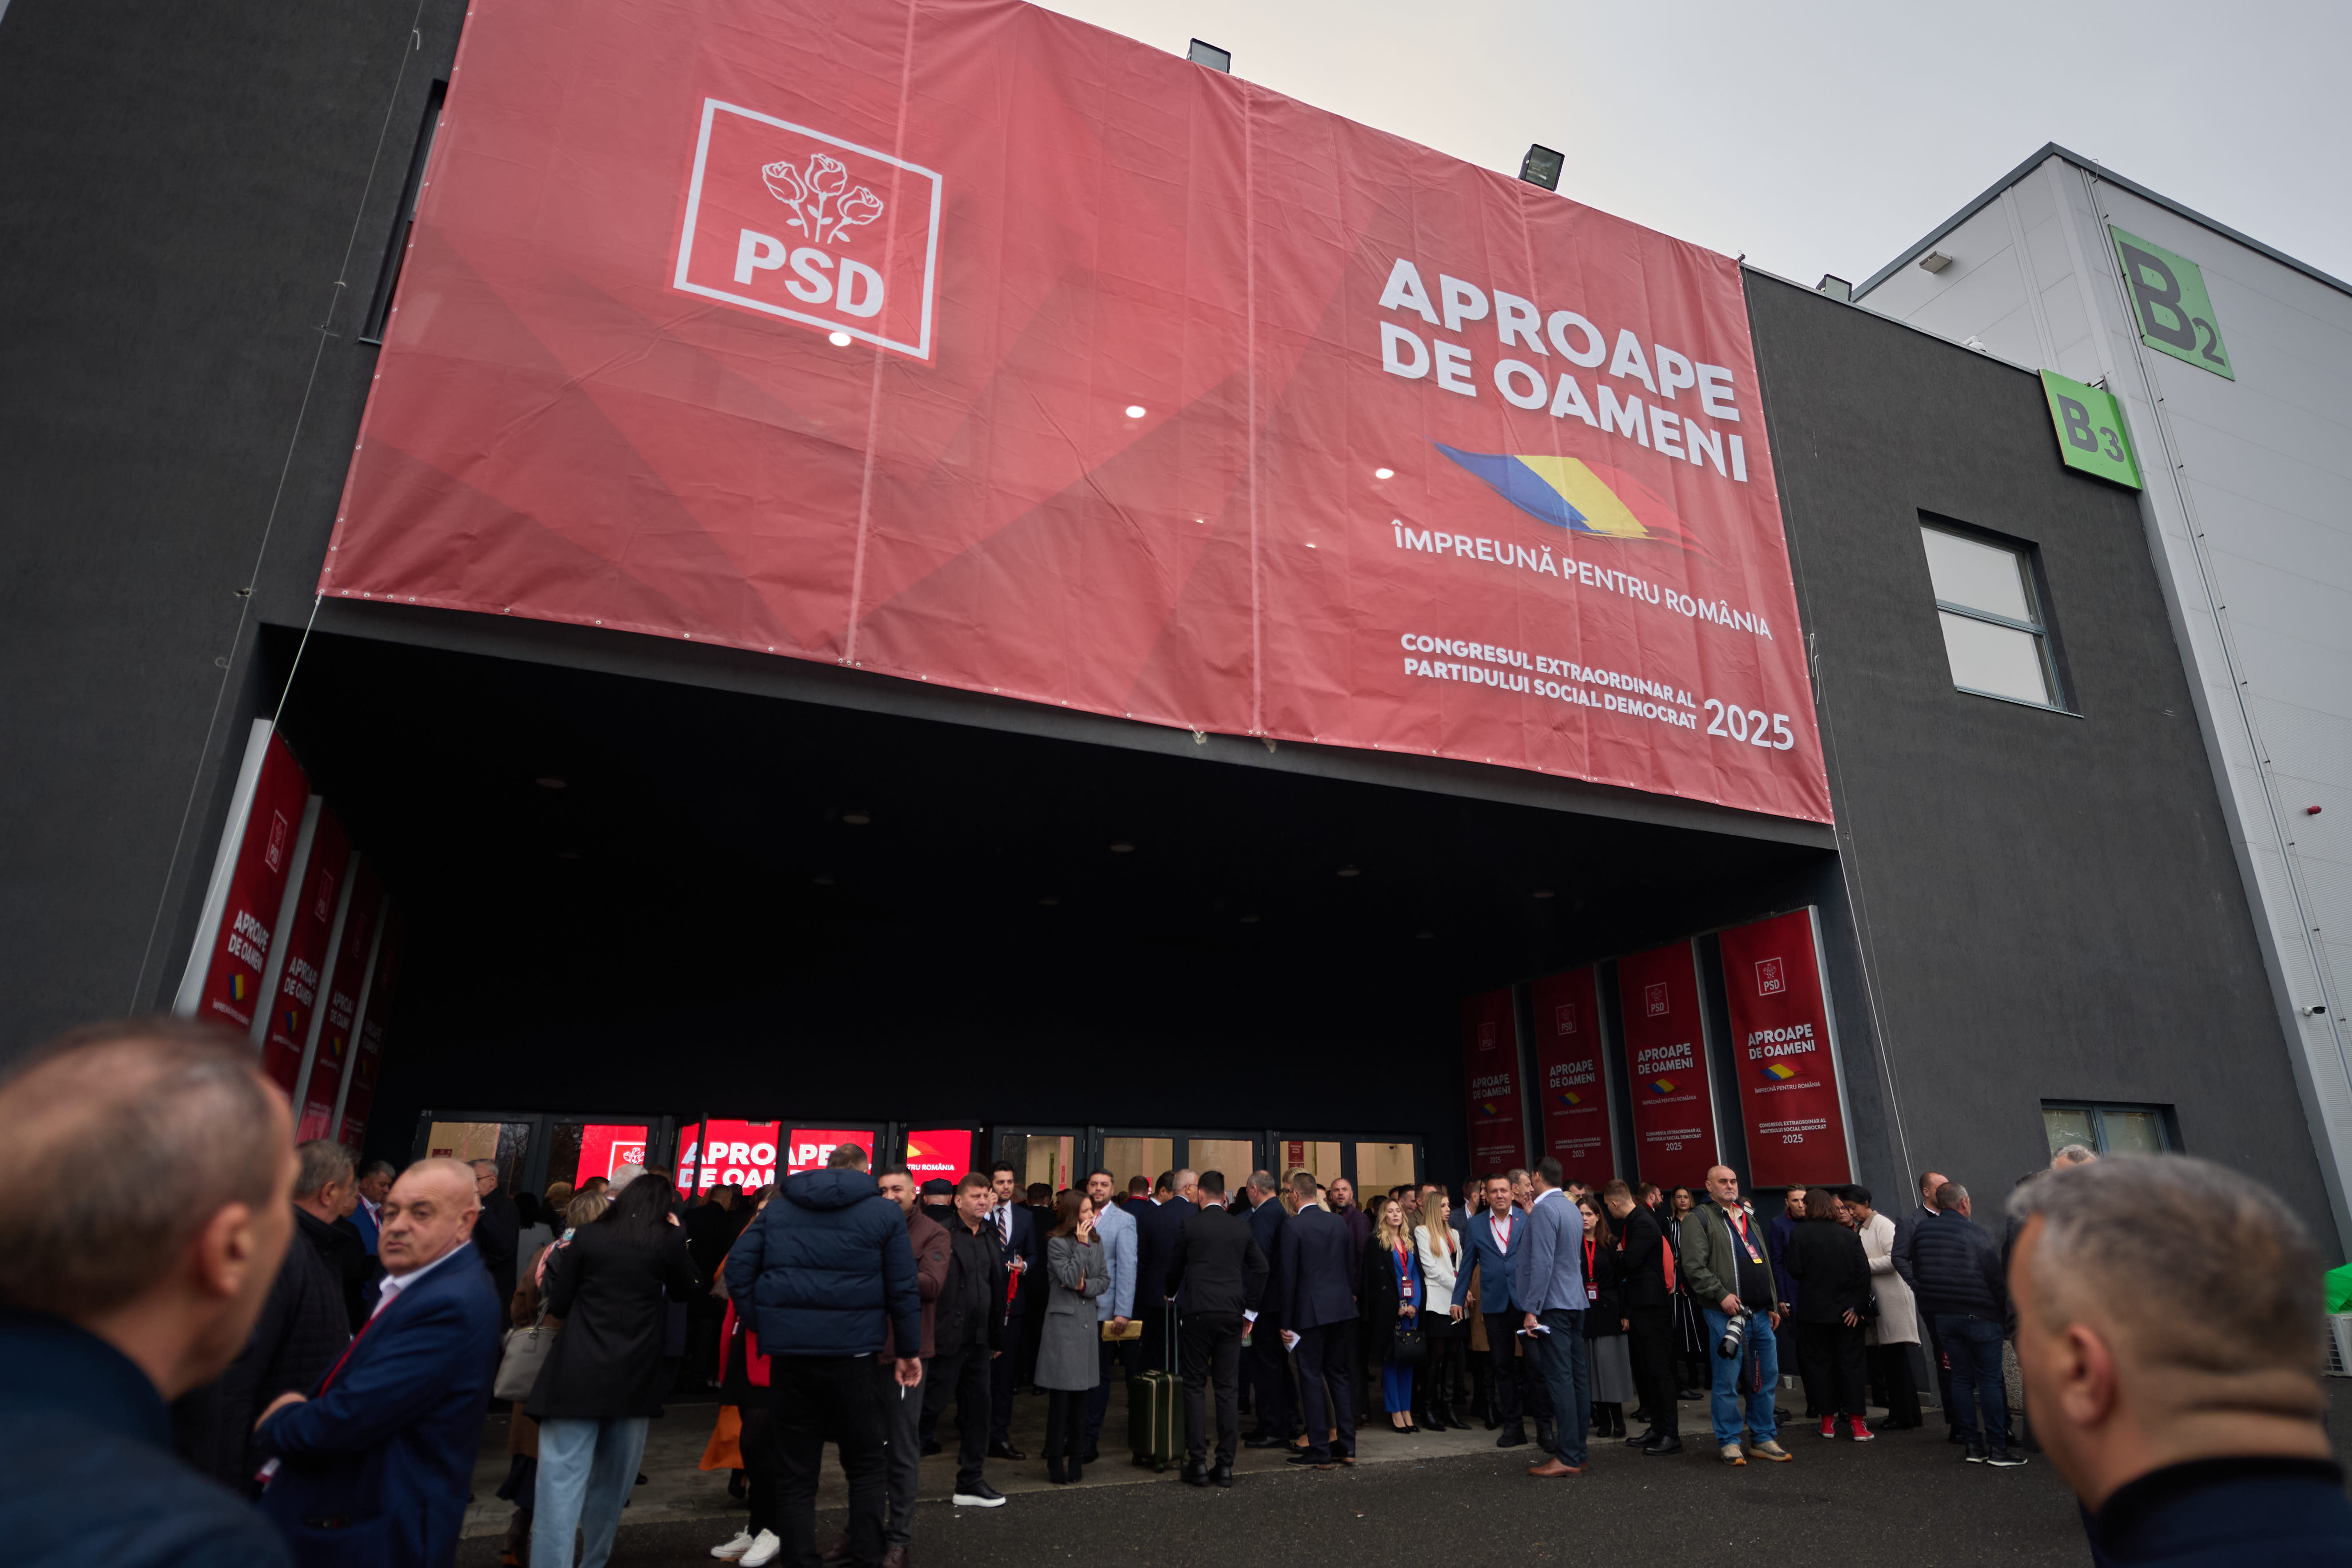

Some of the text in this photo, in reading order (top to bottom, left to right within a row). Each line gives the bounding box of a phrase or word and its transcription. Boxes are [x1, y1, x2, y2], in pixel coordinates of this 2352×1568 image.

[734, 228, 884, 318] PSD
[2119, 241, 2225, 366] B2
[1379, 258, 1740, 421] APROAPE
[1380, 321, 1747, 482] DE OAMENI
[2056, 393, 2125, 463] B3
[1391, 520, 1772, 640] ÎMPREUNĂ PENTRU ROMÂNIA
[1400, 634, 1696, 709] CONGRESUL EXTRAORDINAR AL
[1404, 659, 1697, 730] PARTIDULUI SOCIAL DEMOCRAT
[1704, 699, 1795, 751] 2025
[233, 909, 270, 953] APROAPE
[228, 934, 243, 957] DE
[1764, 979, 1780, 992] PSD
[1650, 1002, 1665, 1013] PSD
[1748, 1024, 1814, 1047] APROAPE
[1638, 1043, 1692, 1062] APROAPE
[1748, 1040, 1816, 1060] DE OAMENI
[1549, 1059, 1594, 1077] APROAPE
[1638, 1057, 1693, 1075] DE OAMENI
[1472, 1073, 1510, 1089] APROAPE
[1549, 1072, 1596, 1088] DE OAMENI
[1472, 1085, 1511, 1100] DE OAMENI
[1666, 1142, 1682, 1151] 2025
[1783, 1134, 1804, 1144] 2025
[1572, 1150, 1585, 1158] 2025
[922, 1163, 955, 1171] ROMÂNIA
[678, 1168, 717, 1188] DE
